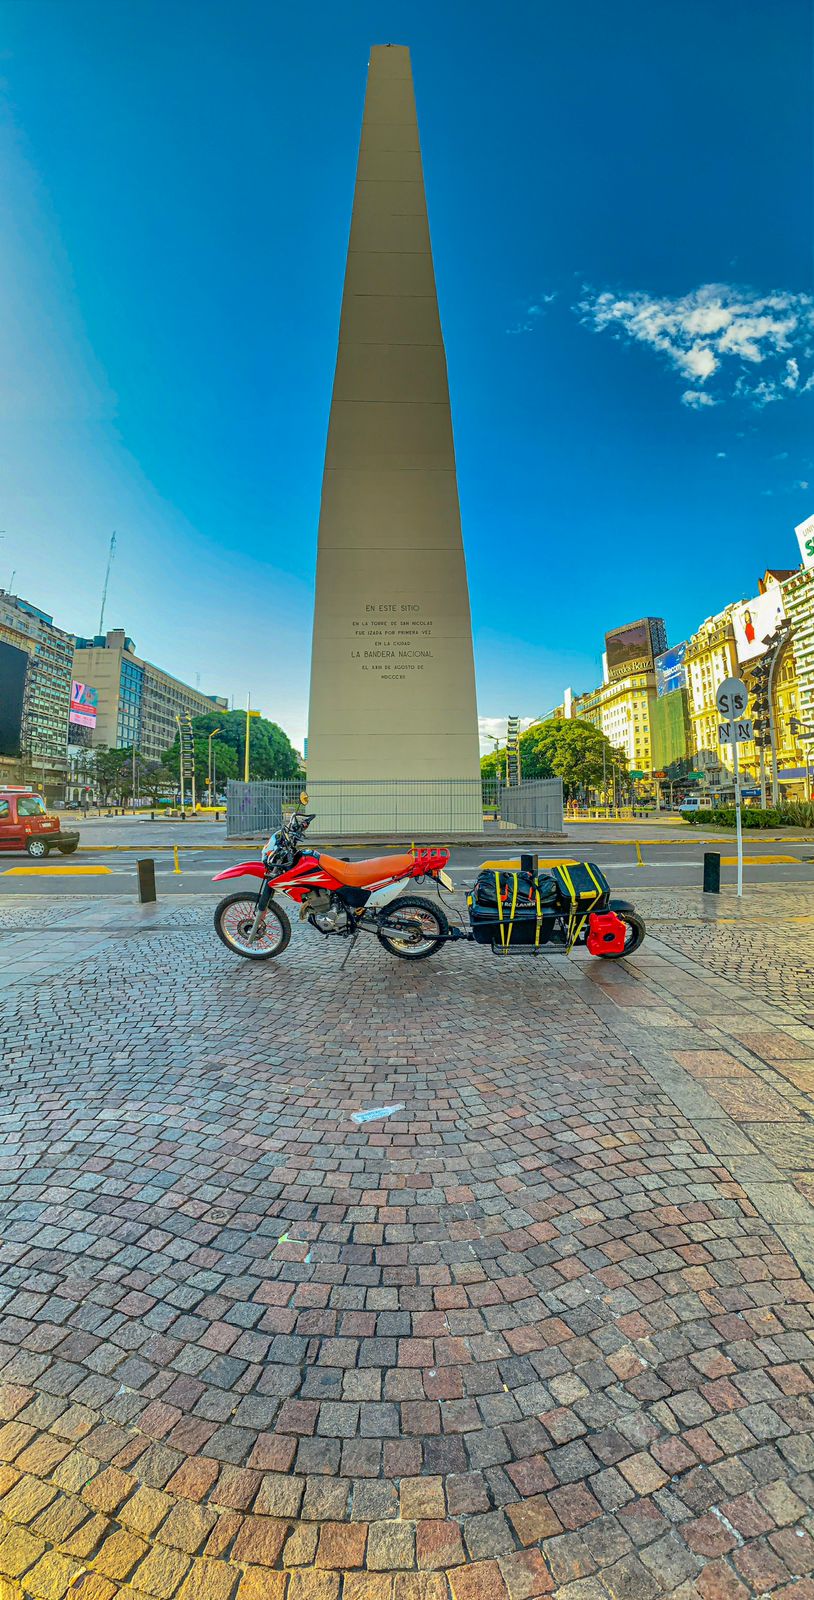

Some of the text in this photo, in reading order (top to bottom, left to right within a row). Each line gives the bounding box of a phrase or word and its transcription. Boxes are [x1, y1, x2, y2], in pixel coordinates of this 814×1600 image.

[365, 604, 420, 612] EN ESTE SITIO
[719, 694, 743, 713] S S
